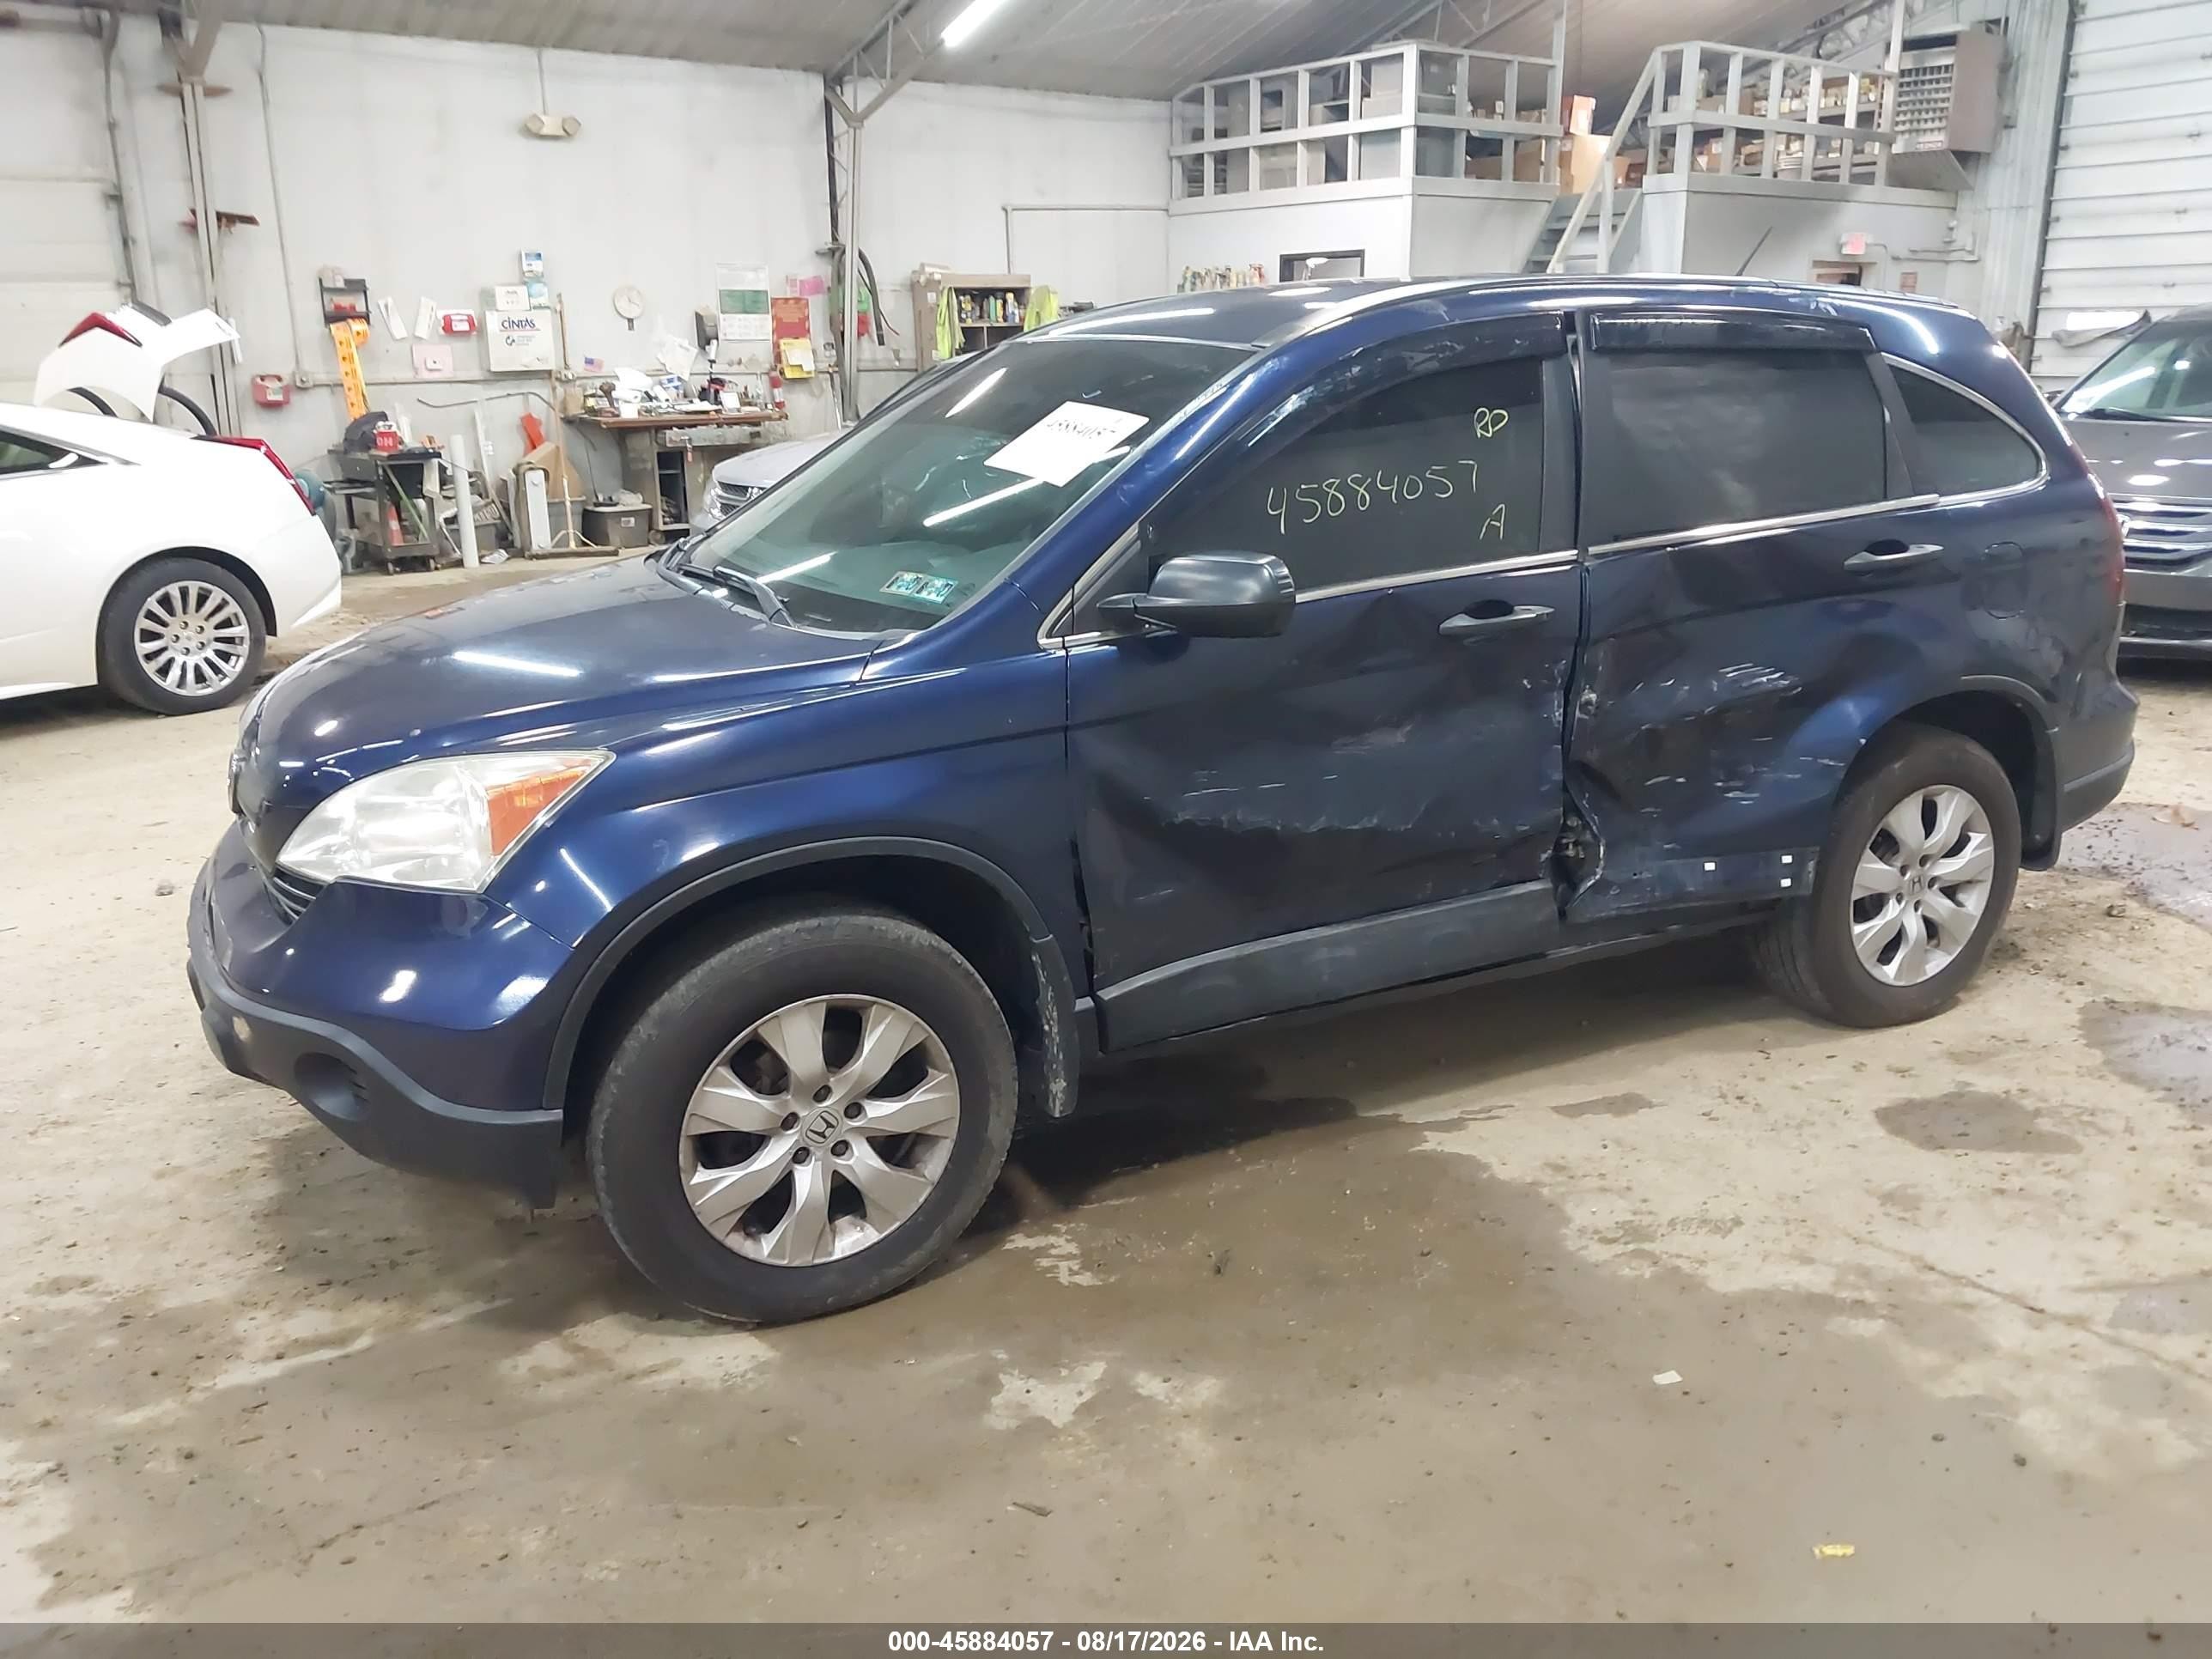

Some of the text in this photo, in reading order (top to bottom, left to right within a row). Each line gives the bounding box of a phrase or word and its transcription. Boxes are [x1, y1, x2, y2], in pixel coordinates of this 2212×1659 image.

[501, 315, 536, 330] CINTAS
[1265, 459, 1479, 535] 45884057
[1479, 503, 1506, 541] A
